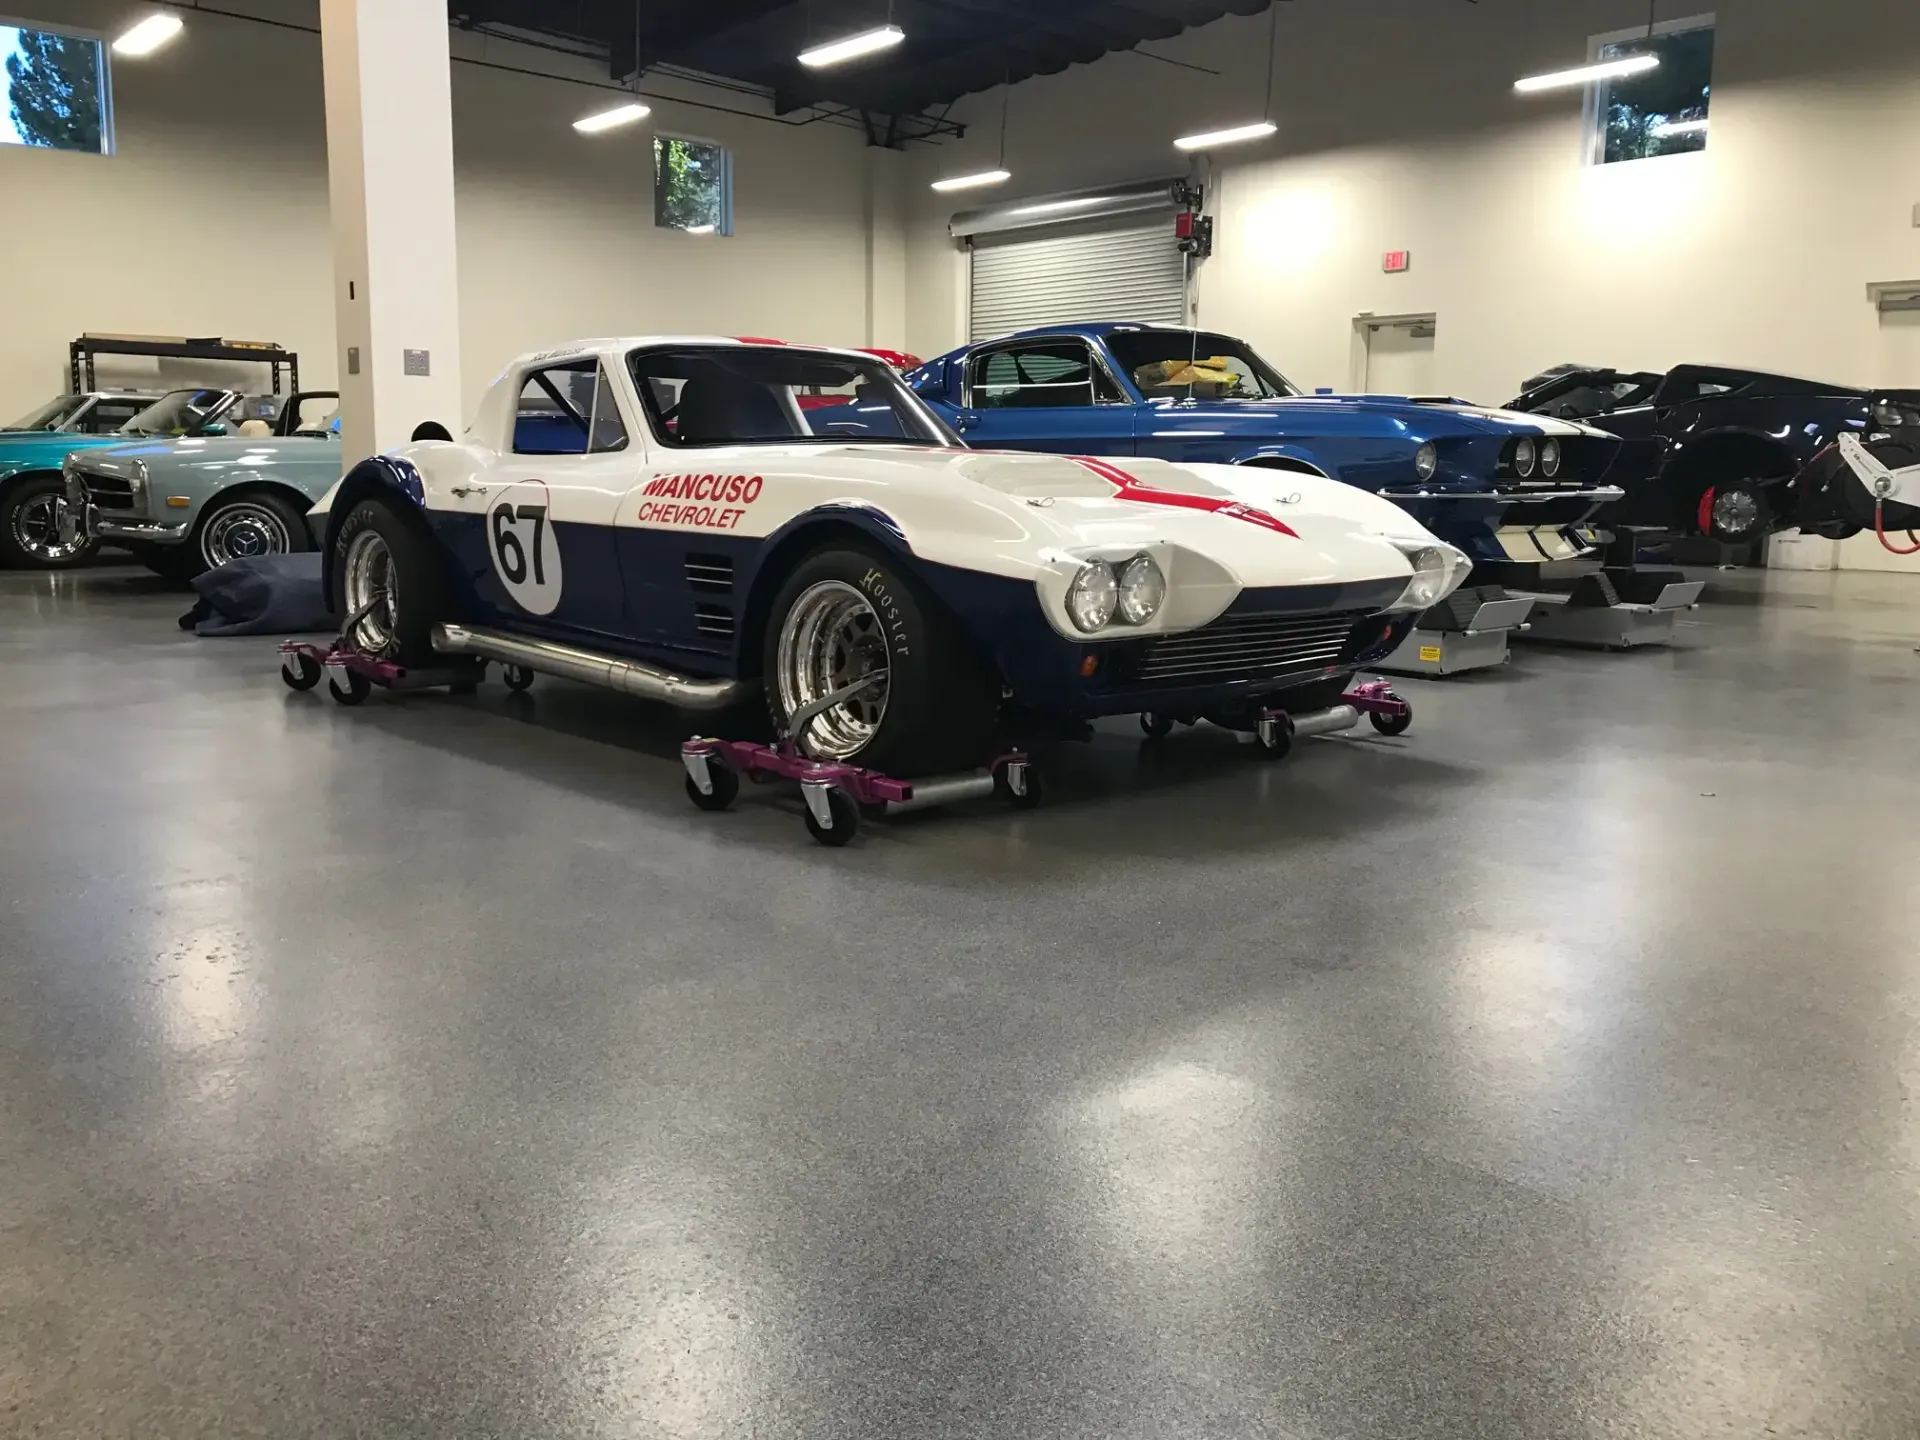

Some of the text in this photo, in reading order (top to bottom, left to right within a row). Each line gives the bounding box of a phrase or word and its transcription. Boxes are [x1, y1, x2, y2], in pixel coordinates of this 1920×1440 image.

[1386, 251, 1404, 269] EXIT
[642, 473, 763, 504] MANCUSO
[638, 502, 746, 529] CHEVROLET
[493, 502, 547, 585] 67
[859, 567, 909, 655] Hoosier
